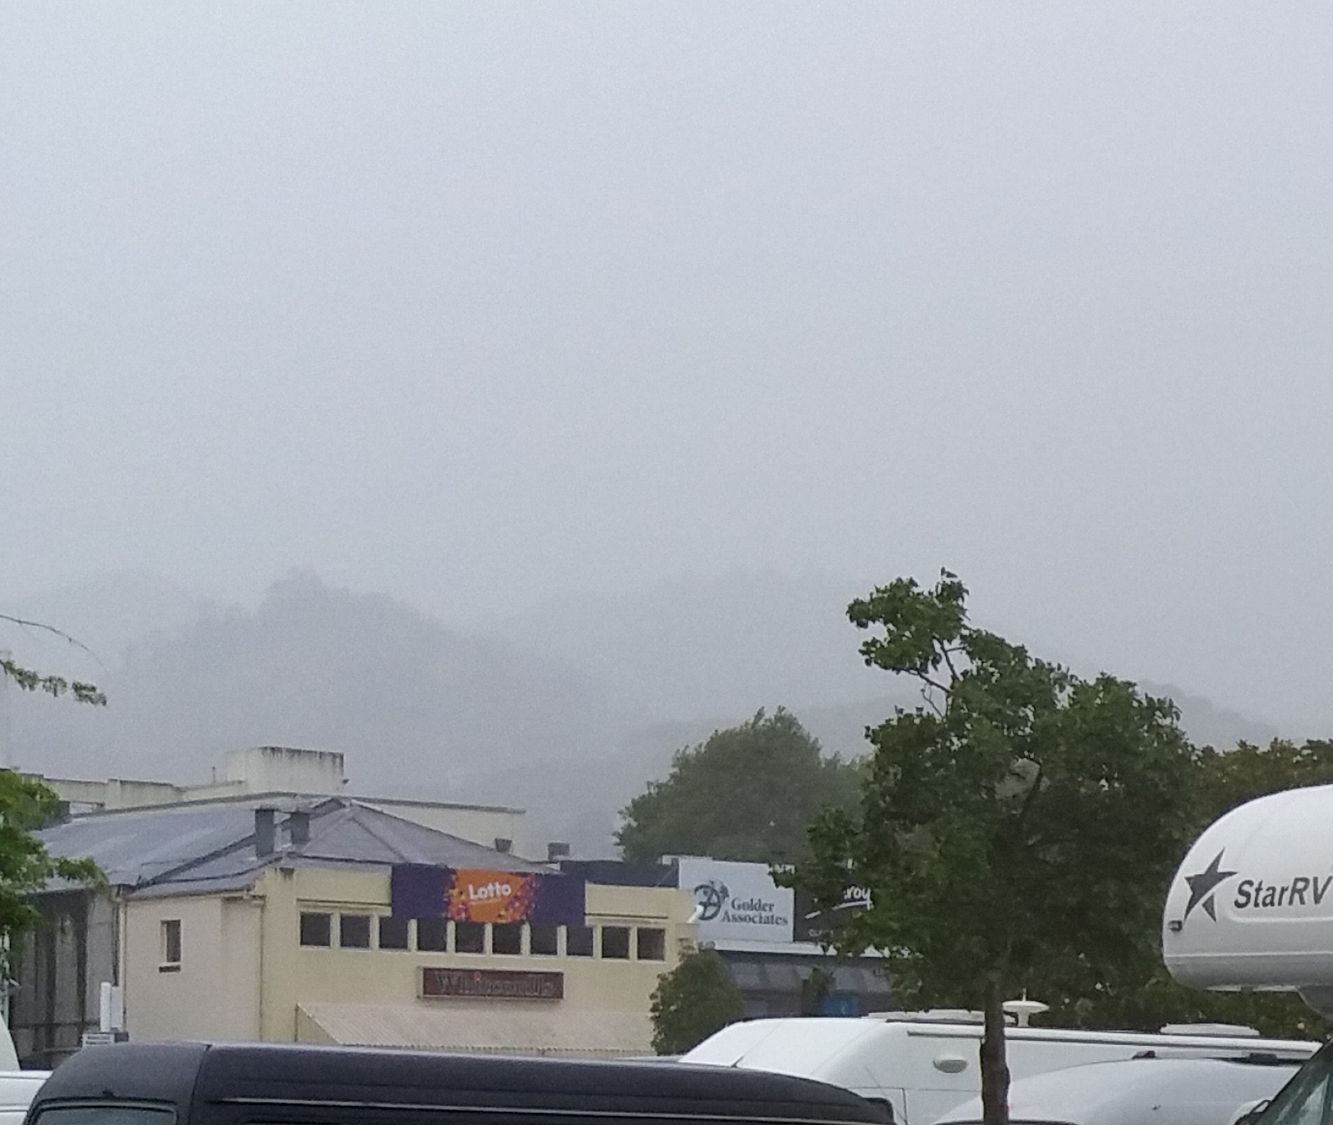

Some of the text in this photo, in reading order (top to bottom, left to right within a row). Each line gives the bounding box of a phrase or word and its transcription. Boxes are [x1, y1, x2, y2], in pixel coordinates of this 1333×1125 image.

[468, 882, 512, 900] Lotto
[1234, 875, 1333, 909] StarRV
[731, 897, 775, 913] Golder
[722, 911, 788, 926] Associates
